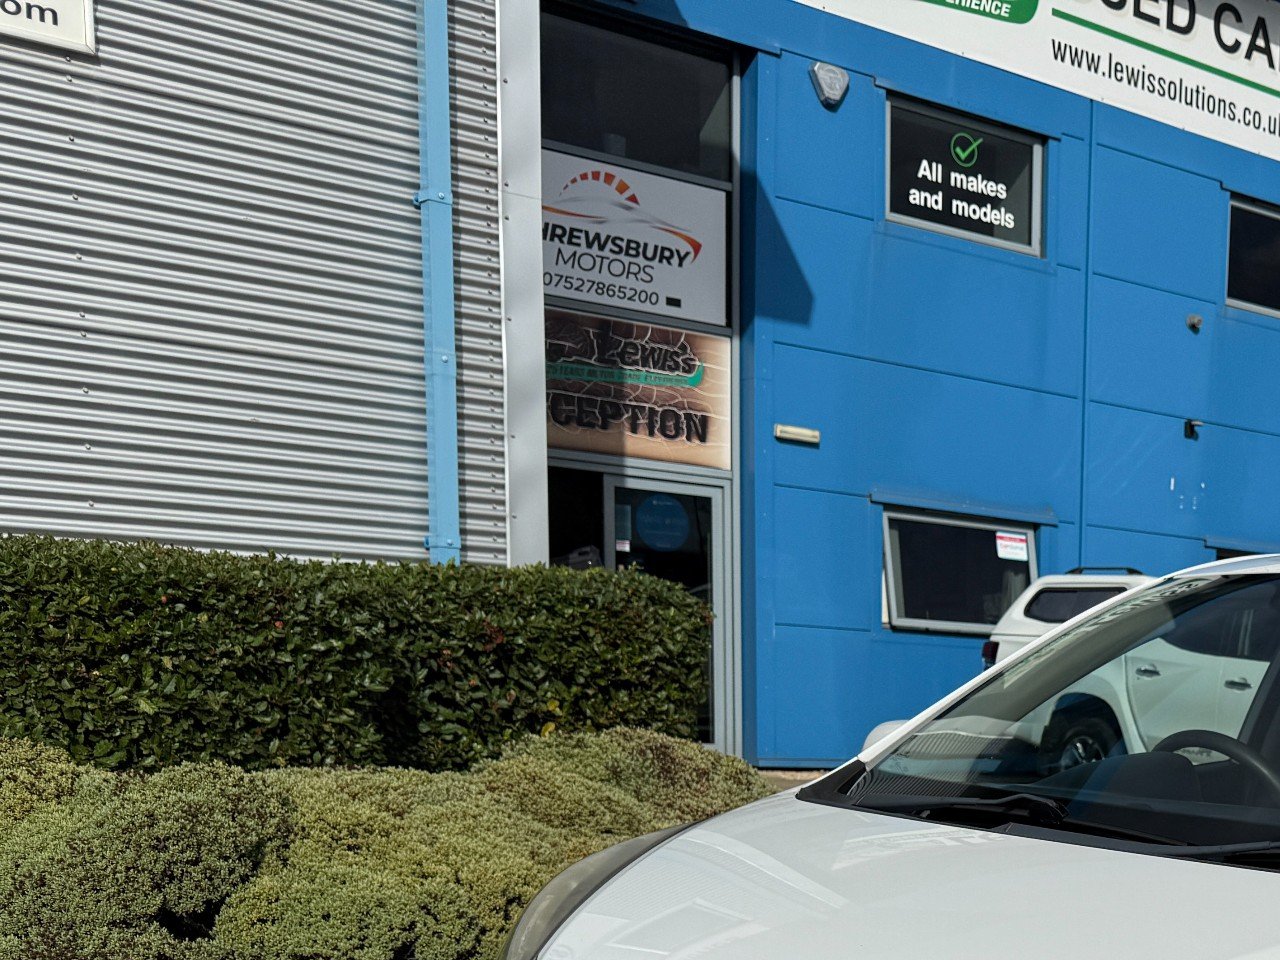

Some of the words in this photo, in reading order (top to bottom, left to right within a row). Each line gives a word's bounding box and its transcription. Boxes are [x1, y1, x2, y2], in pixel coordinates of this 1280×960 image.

[917, 158, 943, 184] All
[949, 171, 1008, 200] makes
[908, 188, 943, 211] and
[951, 199, 1015, 229] models
[555, 247, 655, 283] MOTORS
[543, 271, 659, 306] 07527865200
